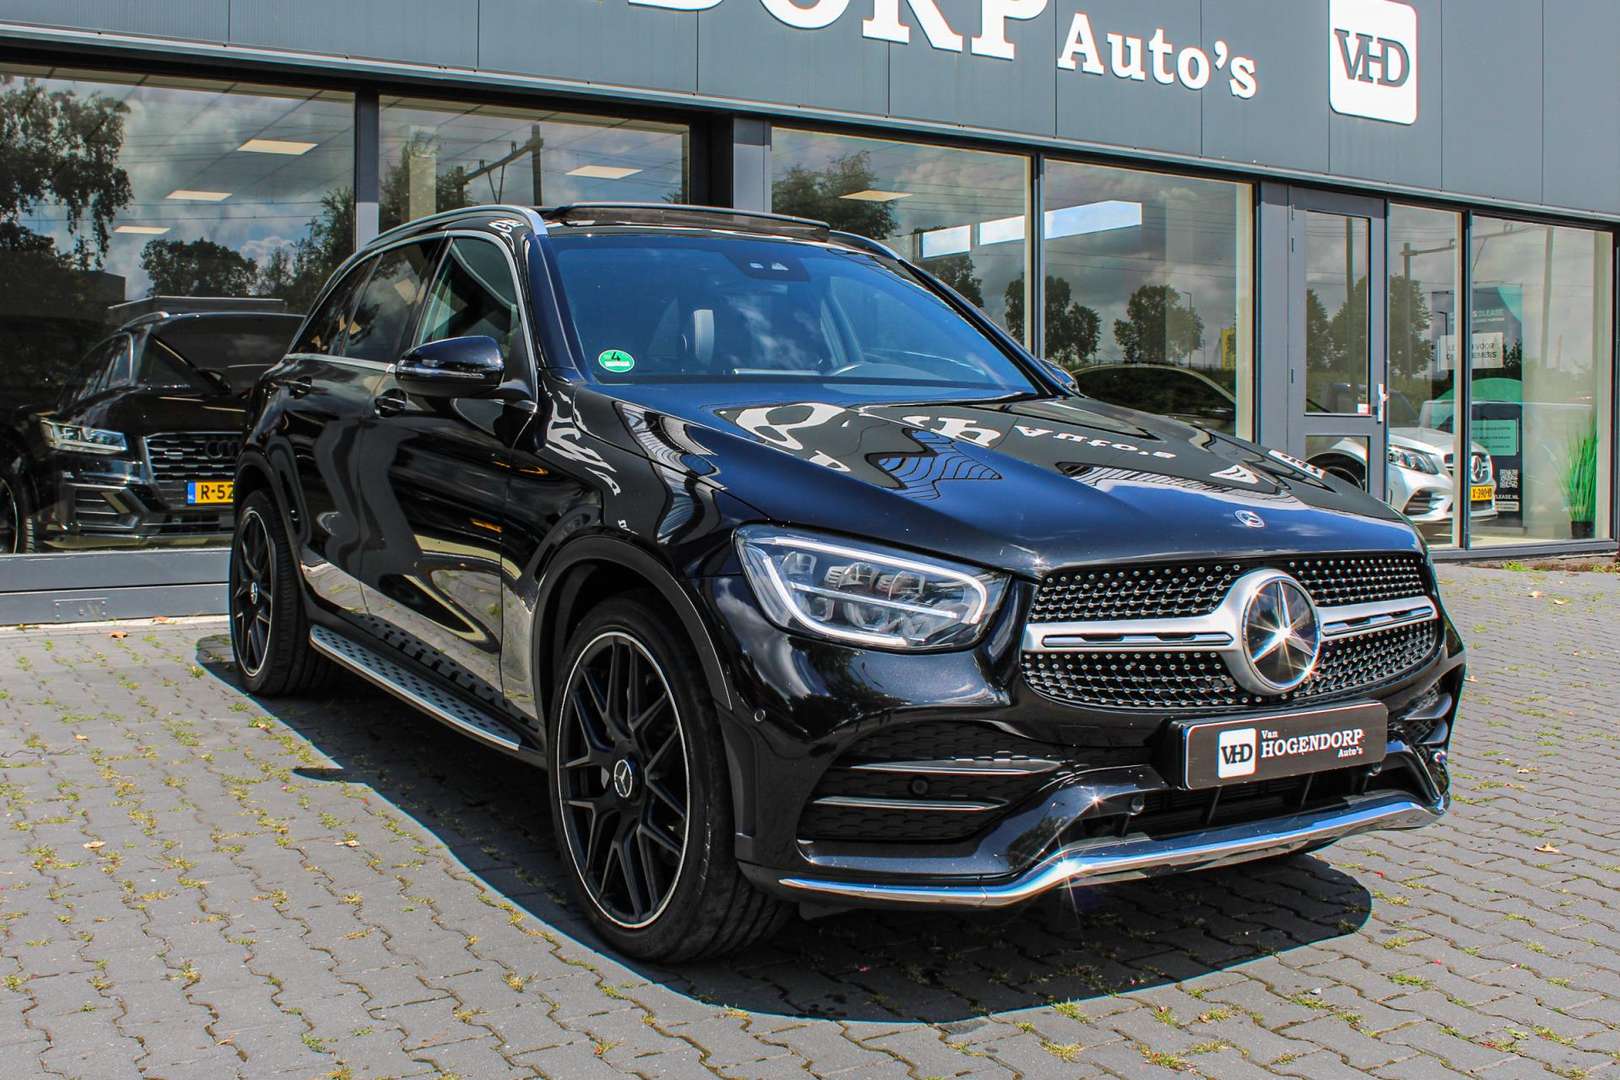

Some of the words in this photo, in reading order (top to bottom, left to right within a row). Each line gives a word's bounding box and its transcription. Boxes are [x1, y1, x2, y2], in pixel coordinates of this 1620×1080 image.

[1057, 11, 1257, 99] Auto's
[1334, 28, 1411, 88] VHD
[1261, 730, 1278, 740] Van
[1261, 729, 1363, 758] HOGENDORP
[1221, 743, 1253, 764] VHD
[1338, 746, 1363, 758] Auto's
